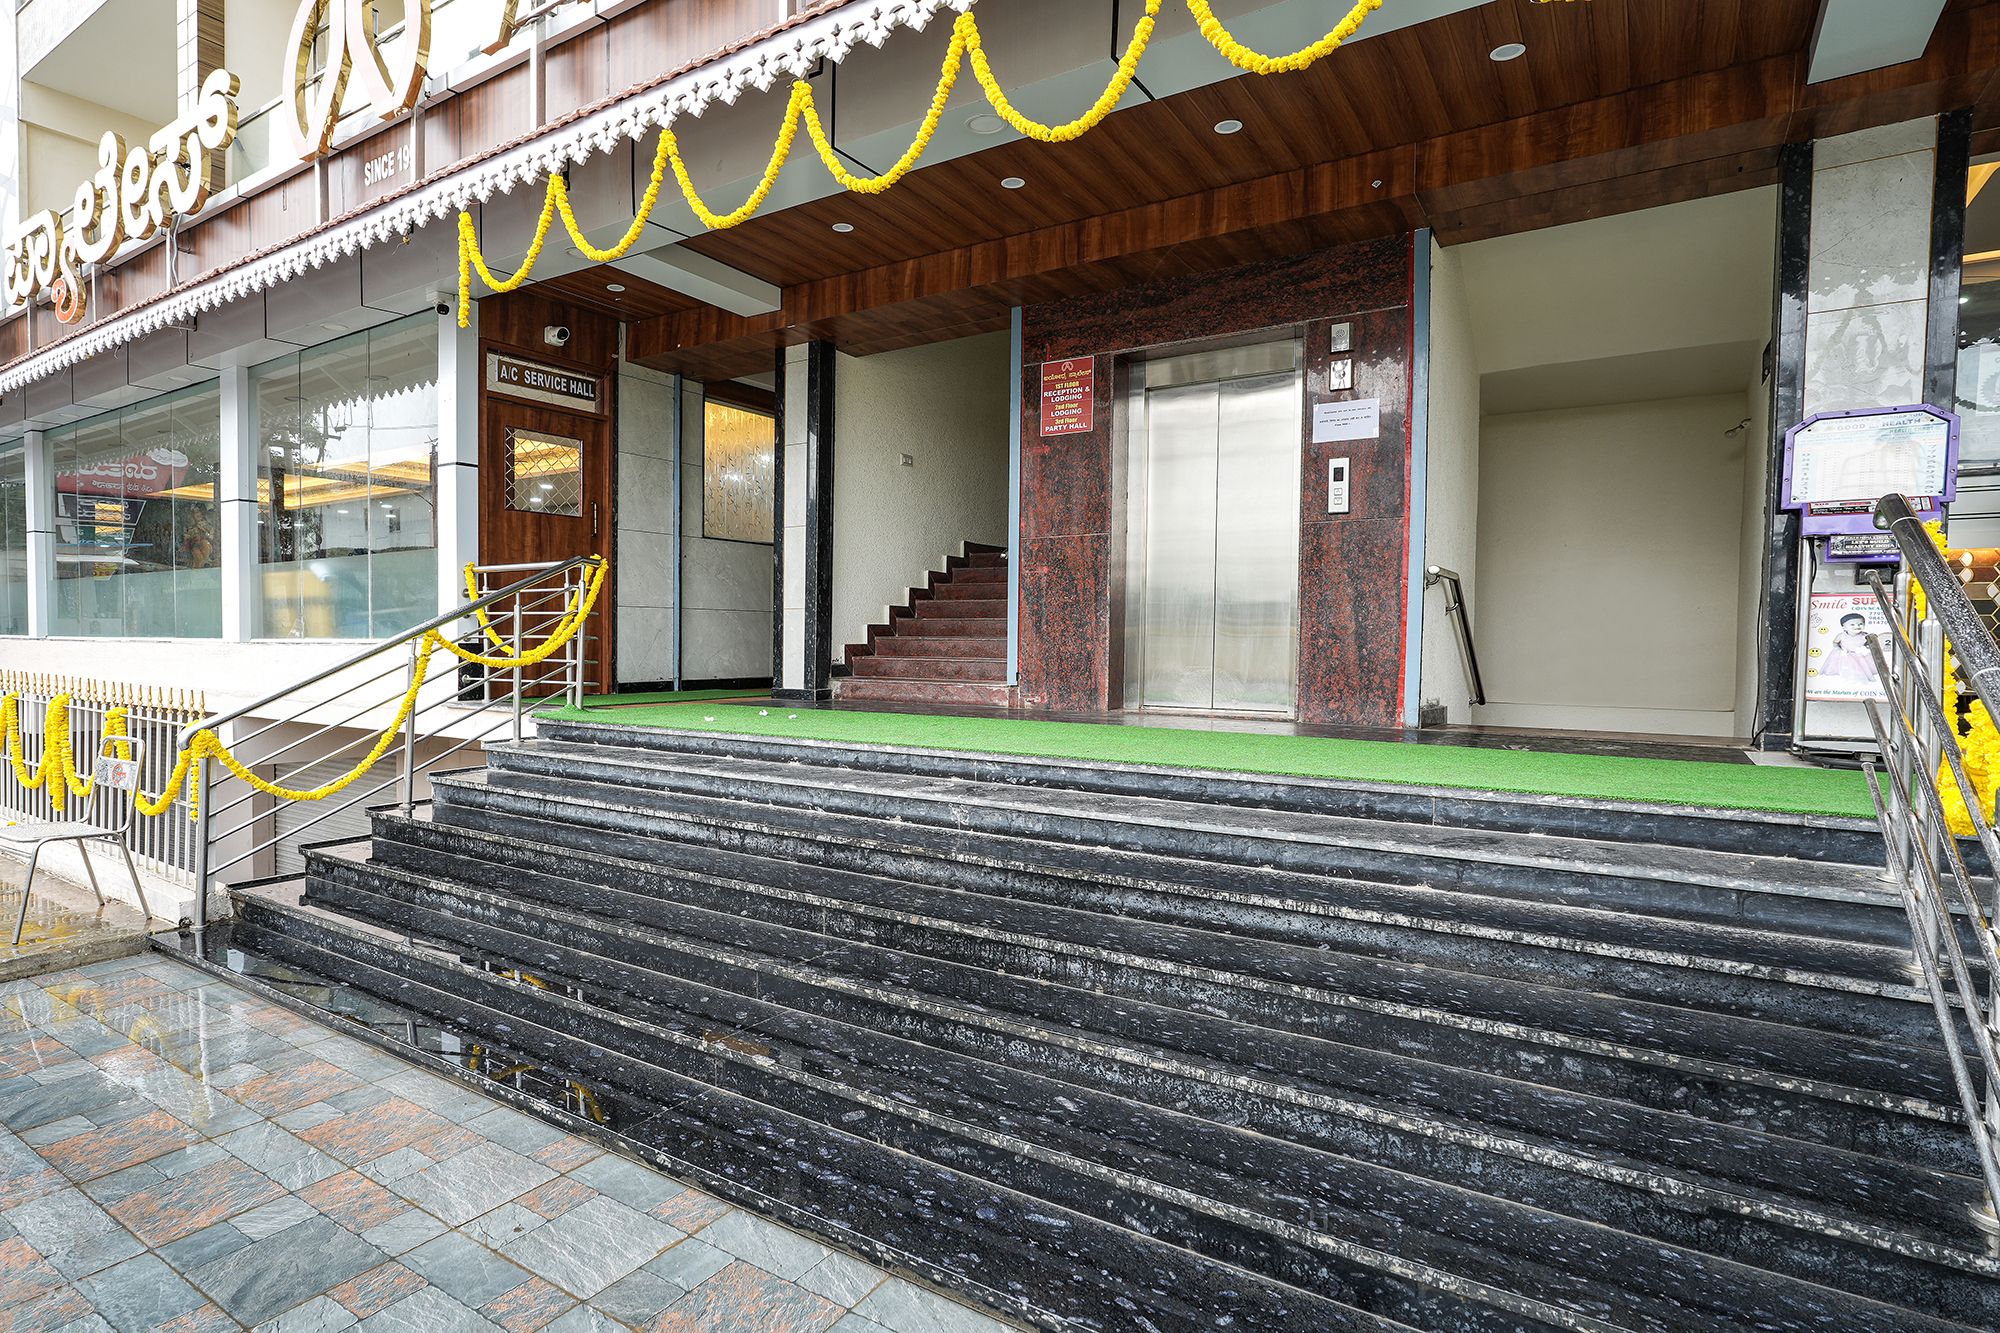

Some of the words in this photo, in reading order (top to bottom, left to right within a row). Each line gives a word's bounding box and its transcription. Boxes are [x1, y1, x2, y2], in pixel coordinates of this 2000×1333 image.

[364, 151, 395, 187] SINCE
[397, 144, 411, 172] 19
[500, 364, 518, 381] A/C
[524, 369, 567, 392] SERVICE
[569, 379, 595, 398] HALL
[1043, 386, 1083, 397] RECEPTION
[1051, 393, 1083, 403] LODGING
[1050, 408, 1082, 417] LODGING
[1881, 418, 1922, 427] HEALTH
[1045, 424, 1068, 432] PARTY
[1810, 598, 1848, 610] Smile
